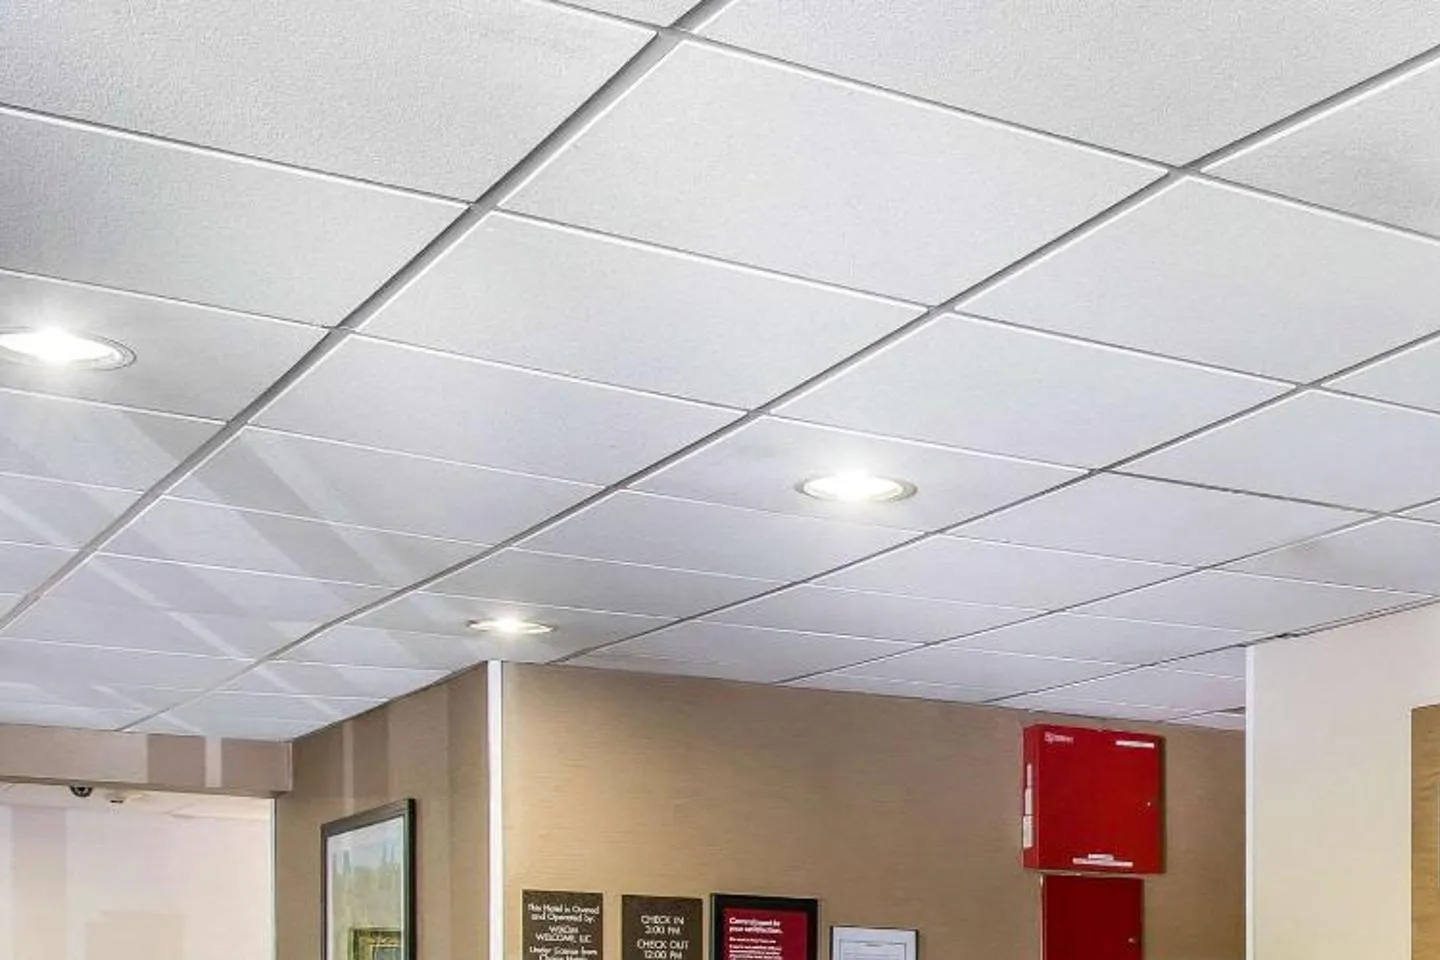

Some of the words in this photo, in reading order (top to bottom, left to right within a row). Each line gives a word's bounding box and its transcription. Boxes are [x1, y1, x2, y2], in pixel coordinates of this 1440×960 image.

[641, 915, 671, 925] CHECK
[673, 916, 685, 925] IN
[637, 939, 668, 950] CHECK
[669, 941, 689, 951] OUT
